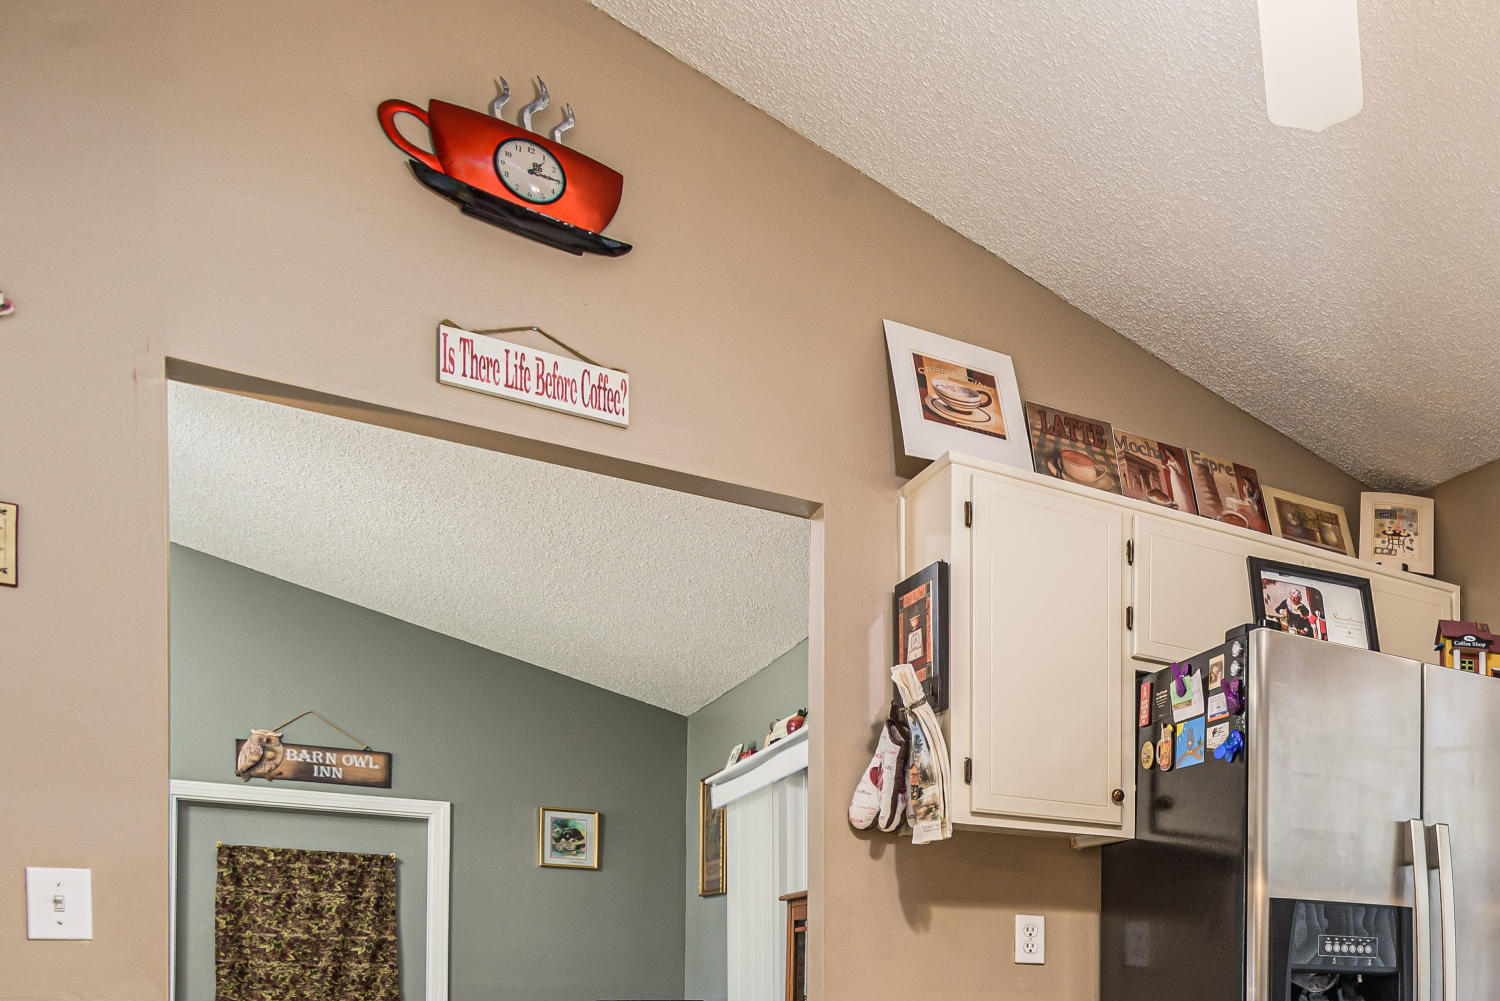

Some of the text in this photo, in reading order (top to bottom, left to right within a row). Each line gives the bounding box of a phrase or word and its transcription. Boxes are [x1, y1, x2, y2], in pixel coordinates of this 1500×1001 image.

[504, 150, 512, 158] 10
[528, 146, 536, 154] 12
[442, 332, 627, 417] Is There Life Before Coffee?
[917, 367, 995, 394] CAPPCINO
[1037, 409, 1107, 449] LATTE
[1113, 435, 1165, 461] Mocha
[1191, 450, 1256, 483] Espres
[1472, 641, 1487, 649] Shop
[286, 748, 381, 769] BARN OWL
[313, 765, 343, 779] INN
